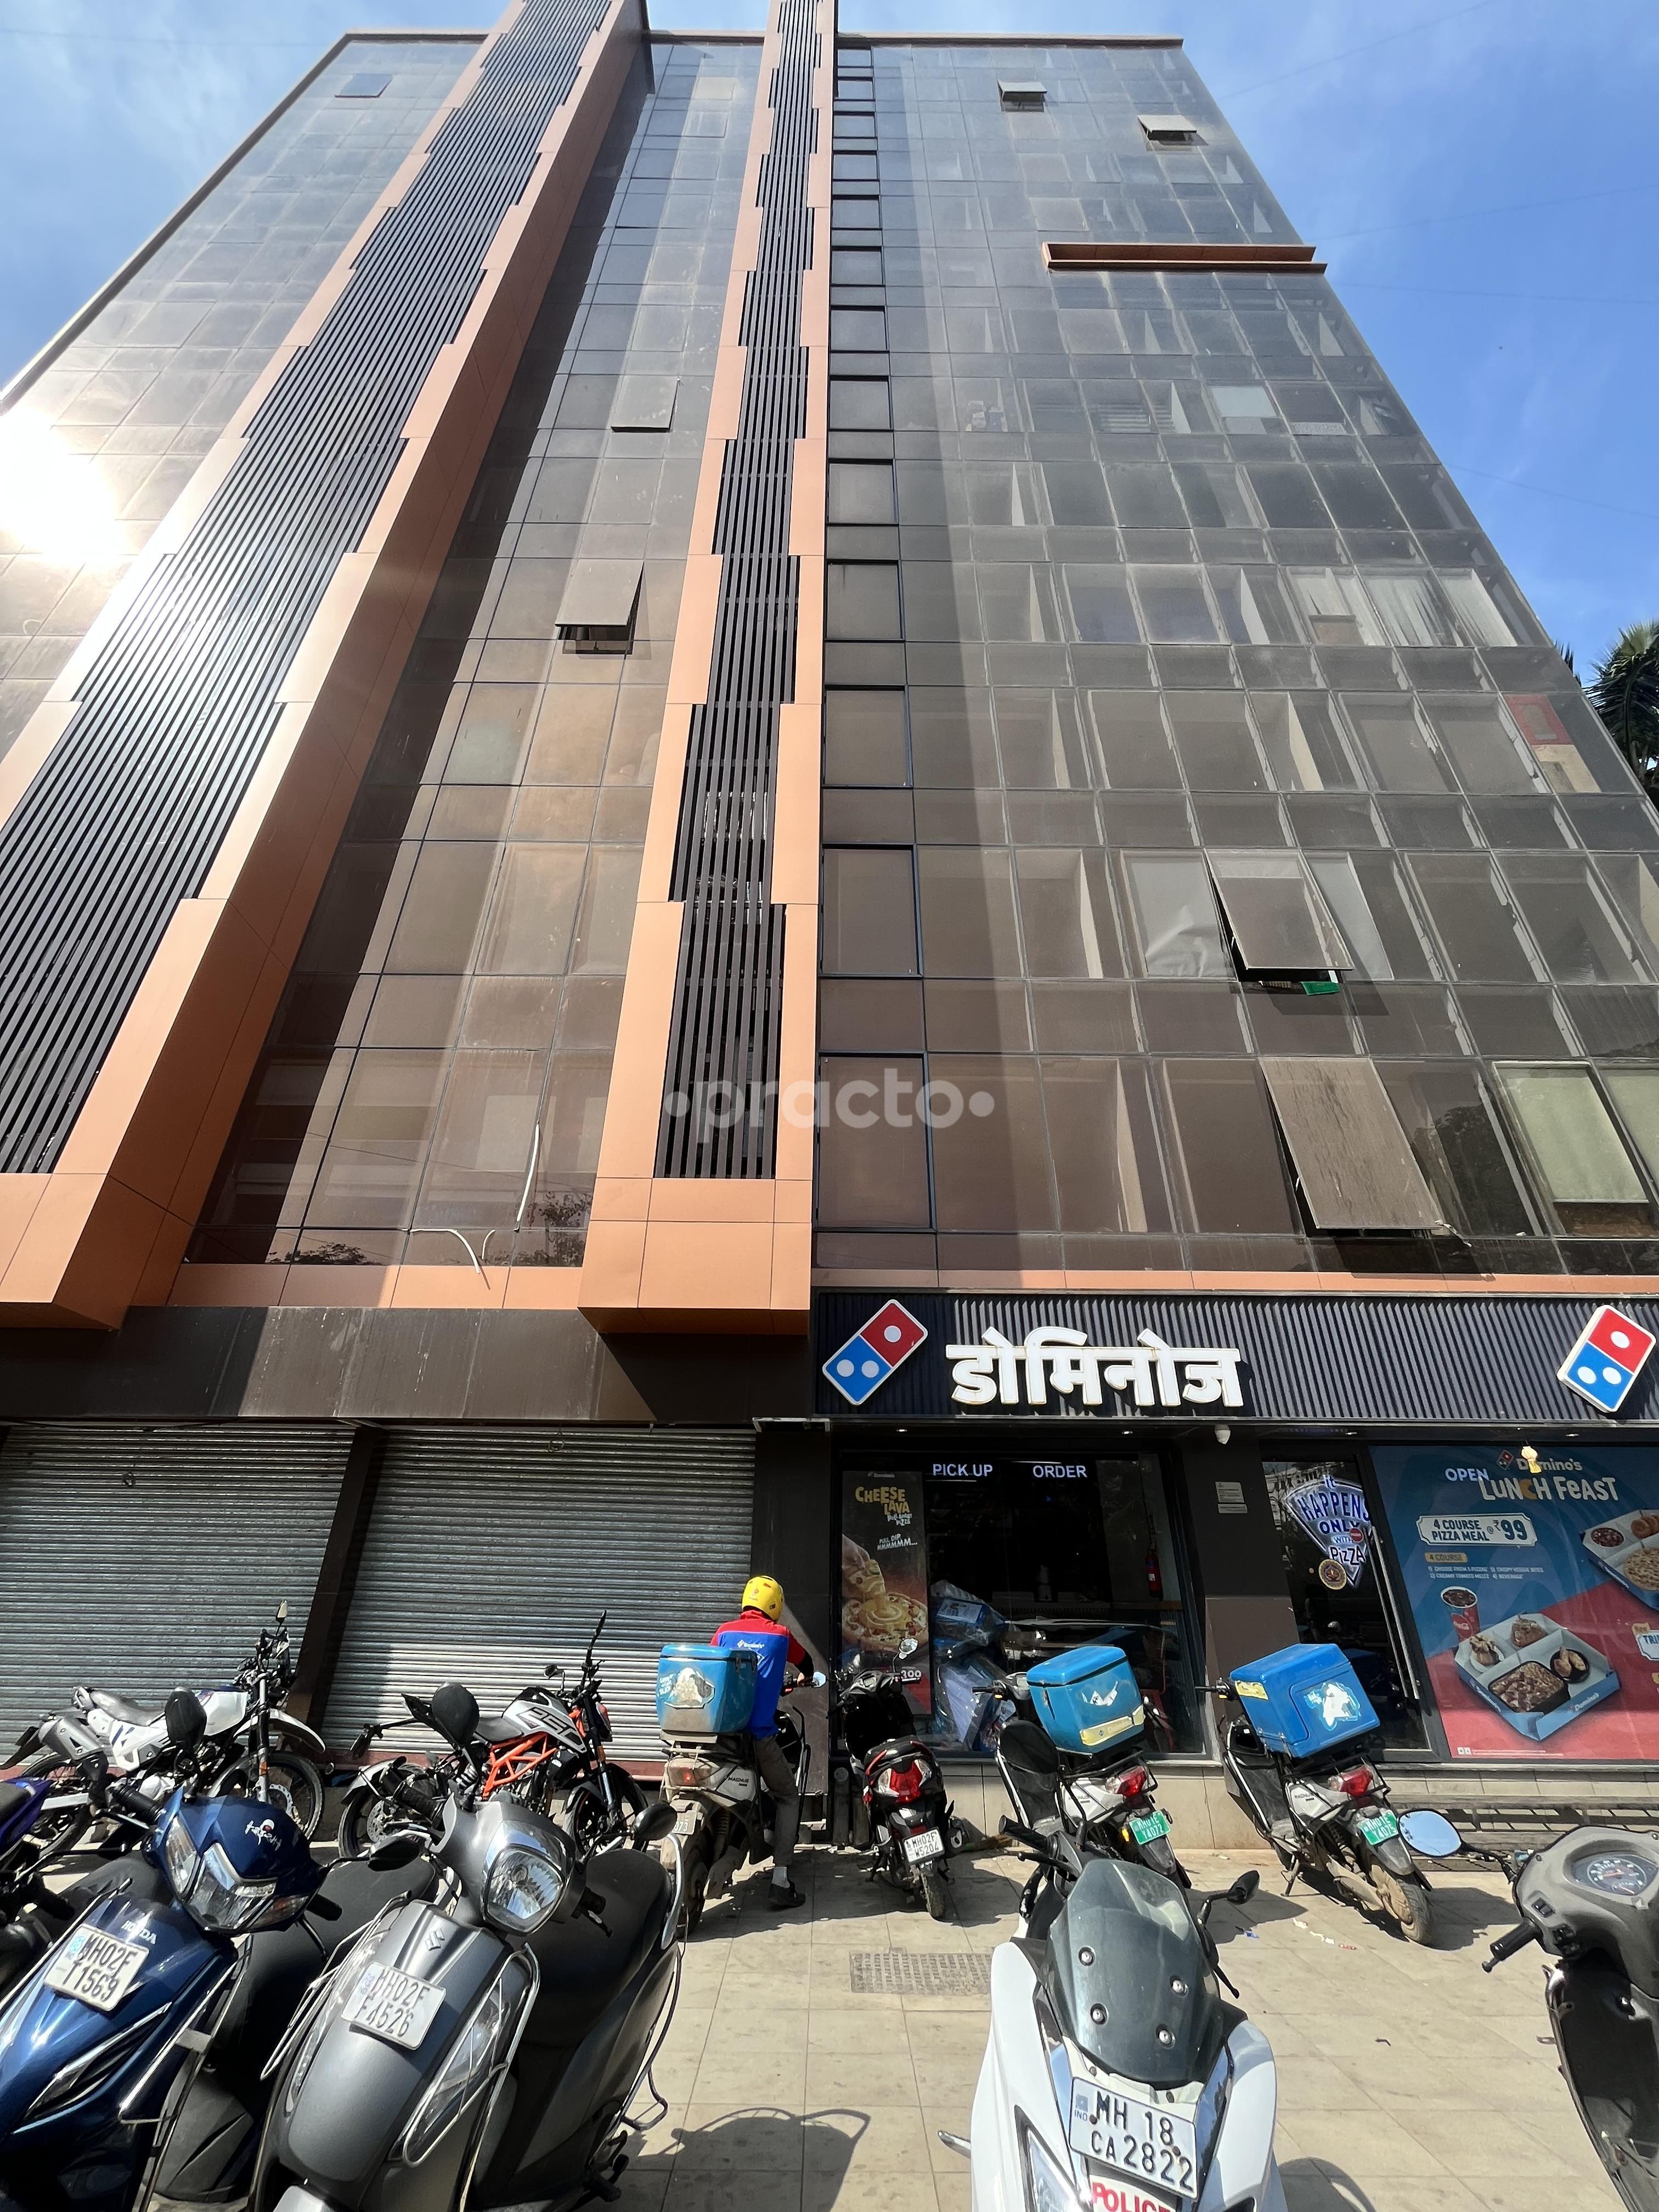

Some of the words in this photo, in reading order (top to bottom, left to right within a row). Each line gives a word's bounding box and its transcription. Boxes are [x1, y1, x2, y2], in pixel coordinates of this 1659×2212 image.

[945, 1326, 1244, 1407] डोमिनोज
[933, 1464, 967, 1476] PICK
[972, 1464, 993, 1477] UP
[1032, 1465, 1088, 1478] ORDER
[1516, 1457, 1583, 1471] Dmino's
[1444, 1468, 1489, 1482] OPEN
[884, 1500, 911, 1515] LAVA
[1319, 1519, 1361, 1534] ONLY
[1433, 1519, 1441, 1529] 4
[1443, 1519, 1480, 1530] COURSE
[1432, 1530, 1459, 1541] PIZZA
[1461, 1531, 1490, 1542] MEAL
[911, 1831, 937, 1848] MH02F
[121, 1920, 157, 1945] HODA
[77, 1933, 138, 1979] MH02F
[62, 1959, 120, 2002] T1569
[1074, 2109, 1088, 2121] IND
[1097, 2091, 1127, 2130] MH
[1144, 2112, 1173, 2146] 18
[1091, 2130, 1194, 2192] CA2822
[1092, 2181, 1171, 2212] POLIC
